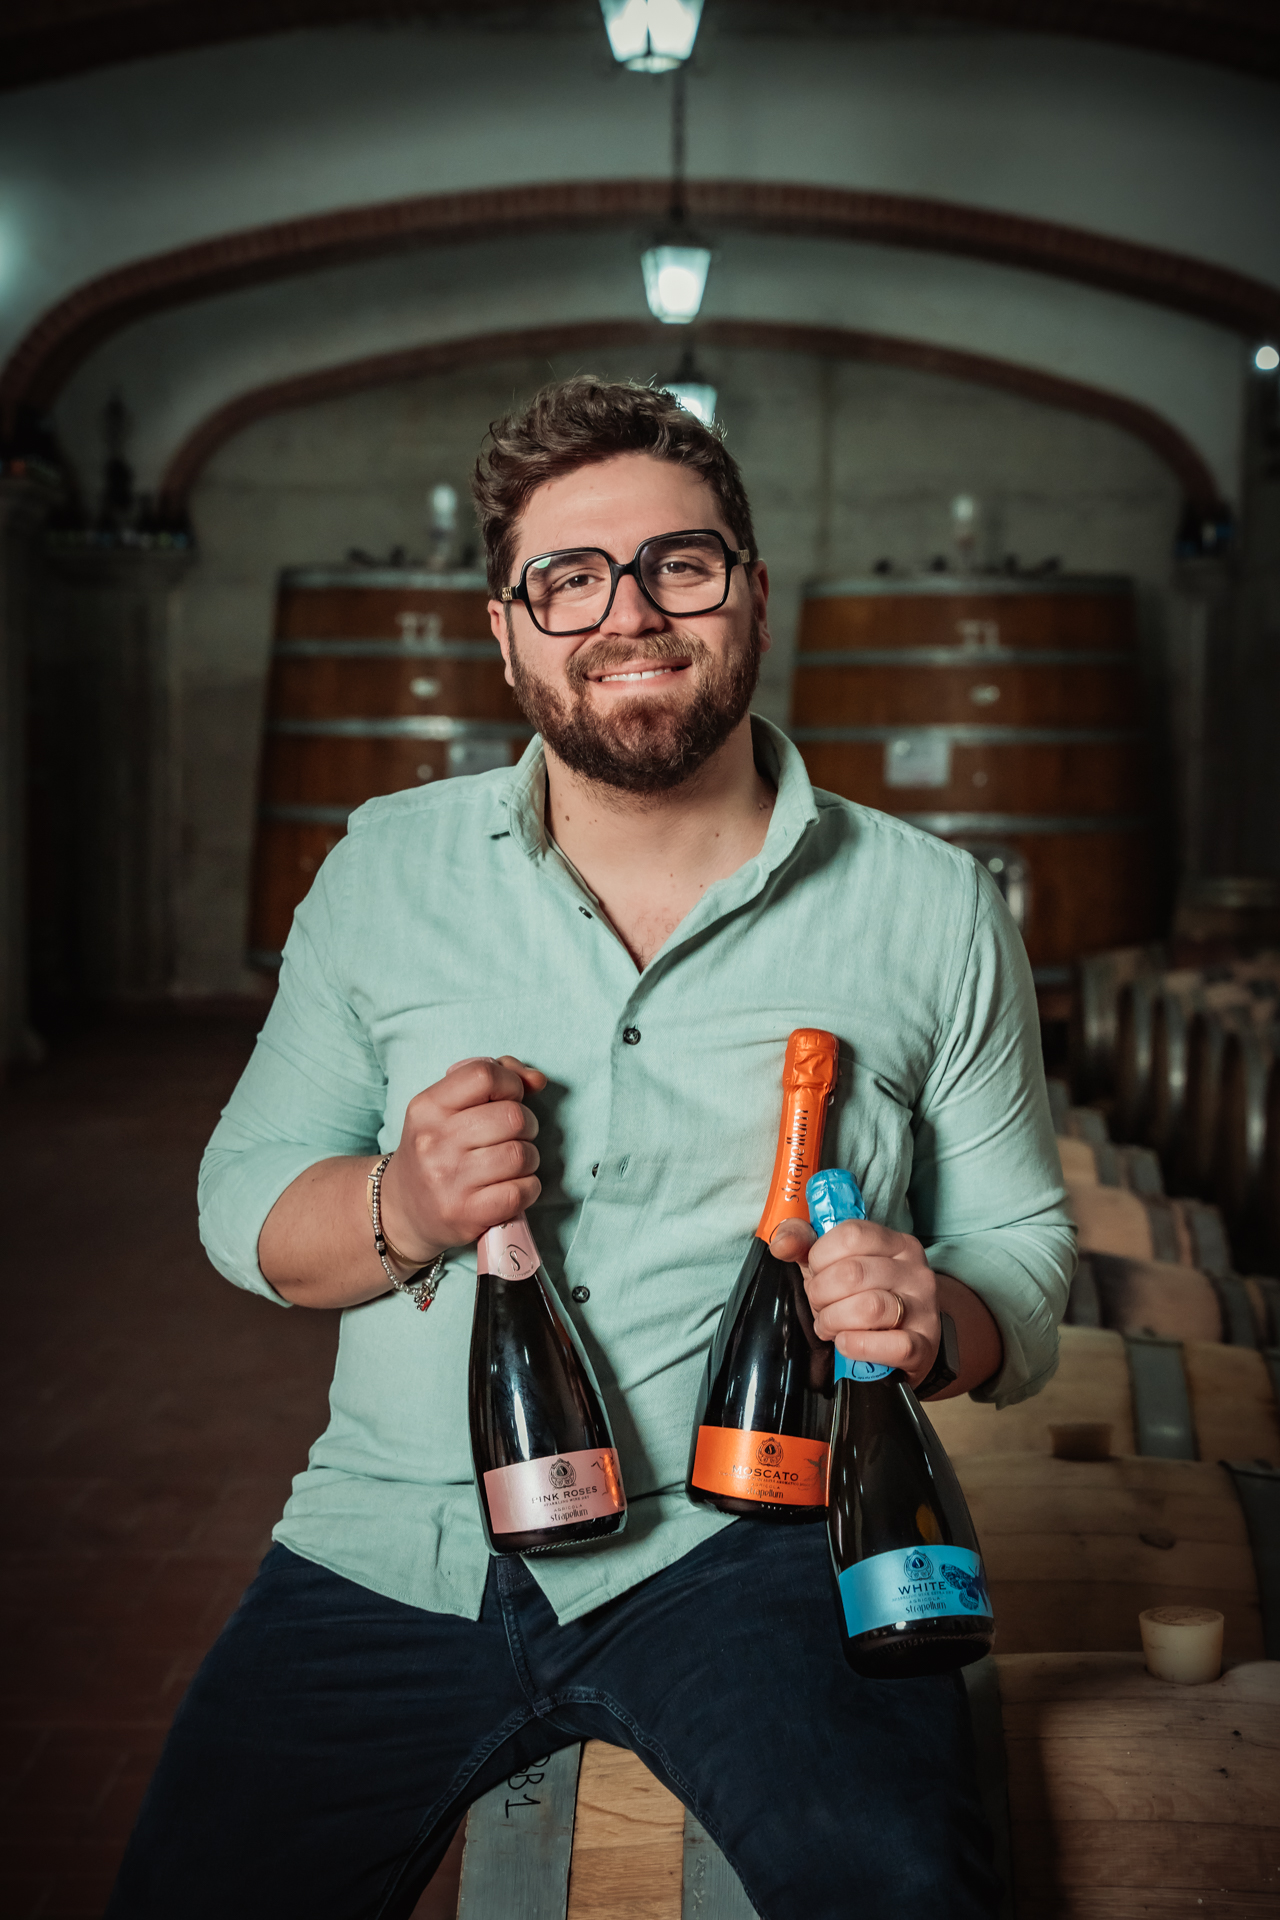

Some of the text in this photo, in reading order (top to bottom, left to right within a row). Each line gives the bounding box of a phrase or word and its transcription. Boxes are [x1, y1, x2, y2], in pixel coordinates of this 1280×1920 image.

[781, 1108, 809, 1203] strapellum
[732, 1464, 799, 1482] MOSCATO
[531, 1485, 598, 1504] PINK ROSES
[746, 1487, 784, 1499] strapellum
[554, 1504, 583, 1512] AGRICOLA
[550, 1508, 589, 1522] strapellum
[898, 1582, 946, 1595] WHITE
[909, 1596, 940, 1604] AGRICOLA
[905, 1601, 947, 1614] strapellum
